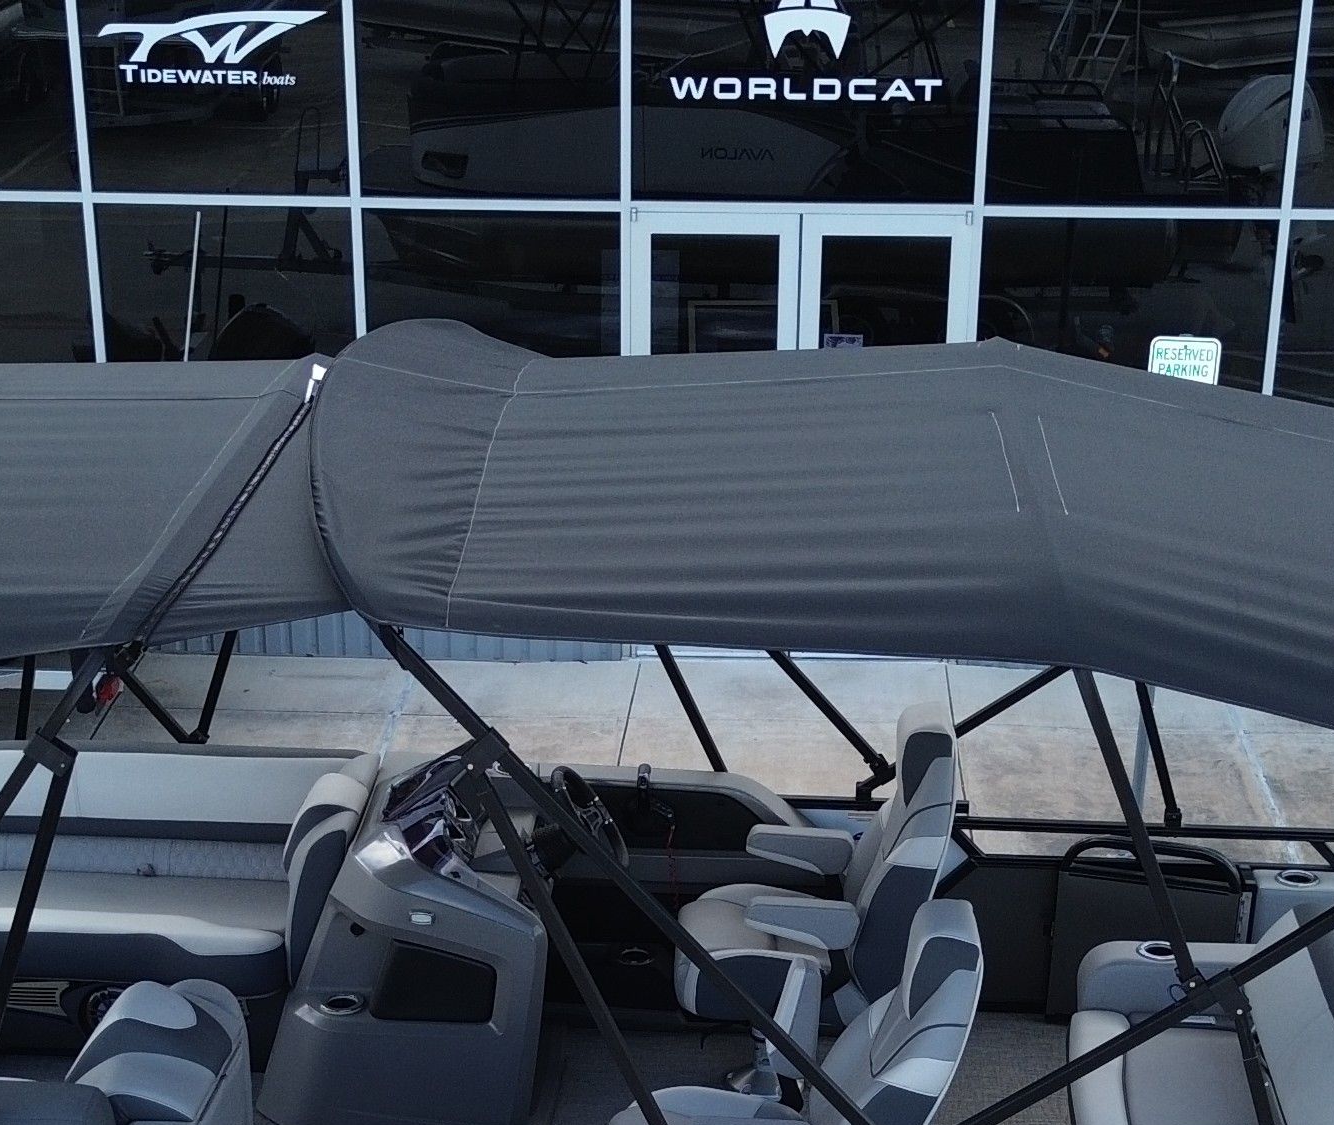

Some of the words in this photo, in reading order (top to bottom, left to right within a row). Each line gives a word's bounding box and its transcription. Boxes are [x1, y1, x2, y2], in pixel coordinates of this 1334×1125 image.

[120, 64, 258, 85] TIDEWATER
[262, 73, 296, 86] boats
[670, 77, 943, 101] WORLDCAT
[1155, 347, 1214, 362] RESERVED
[1157, 363, 1209, 378] PARKING
